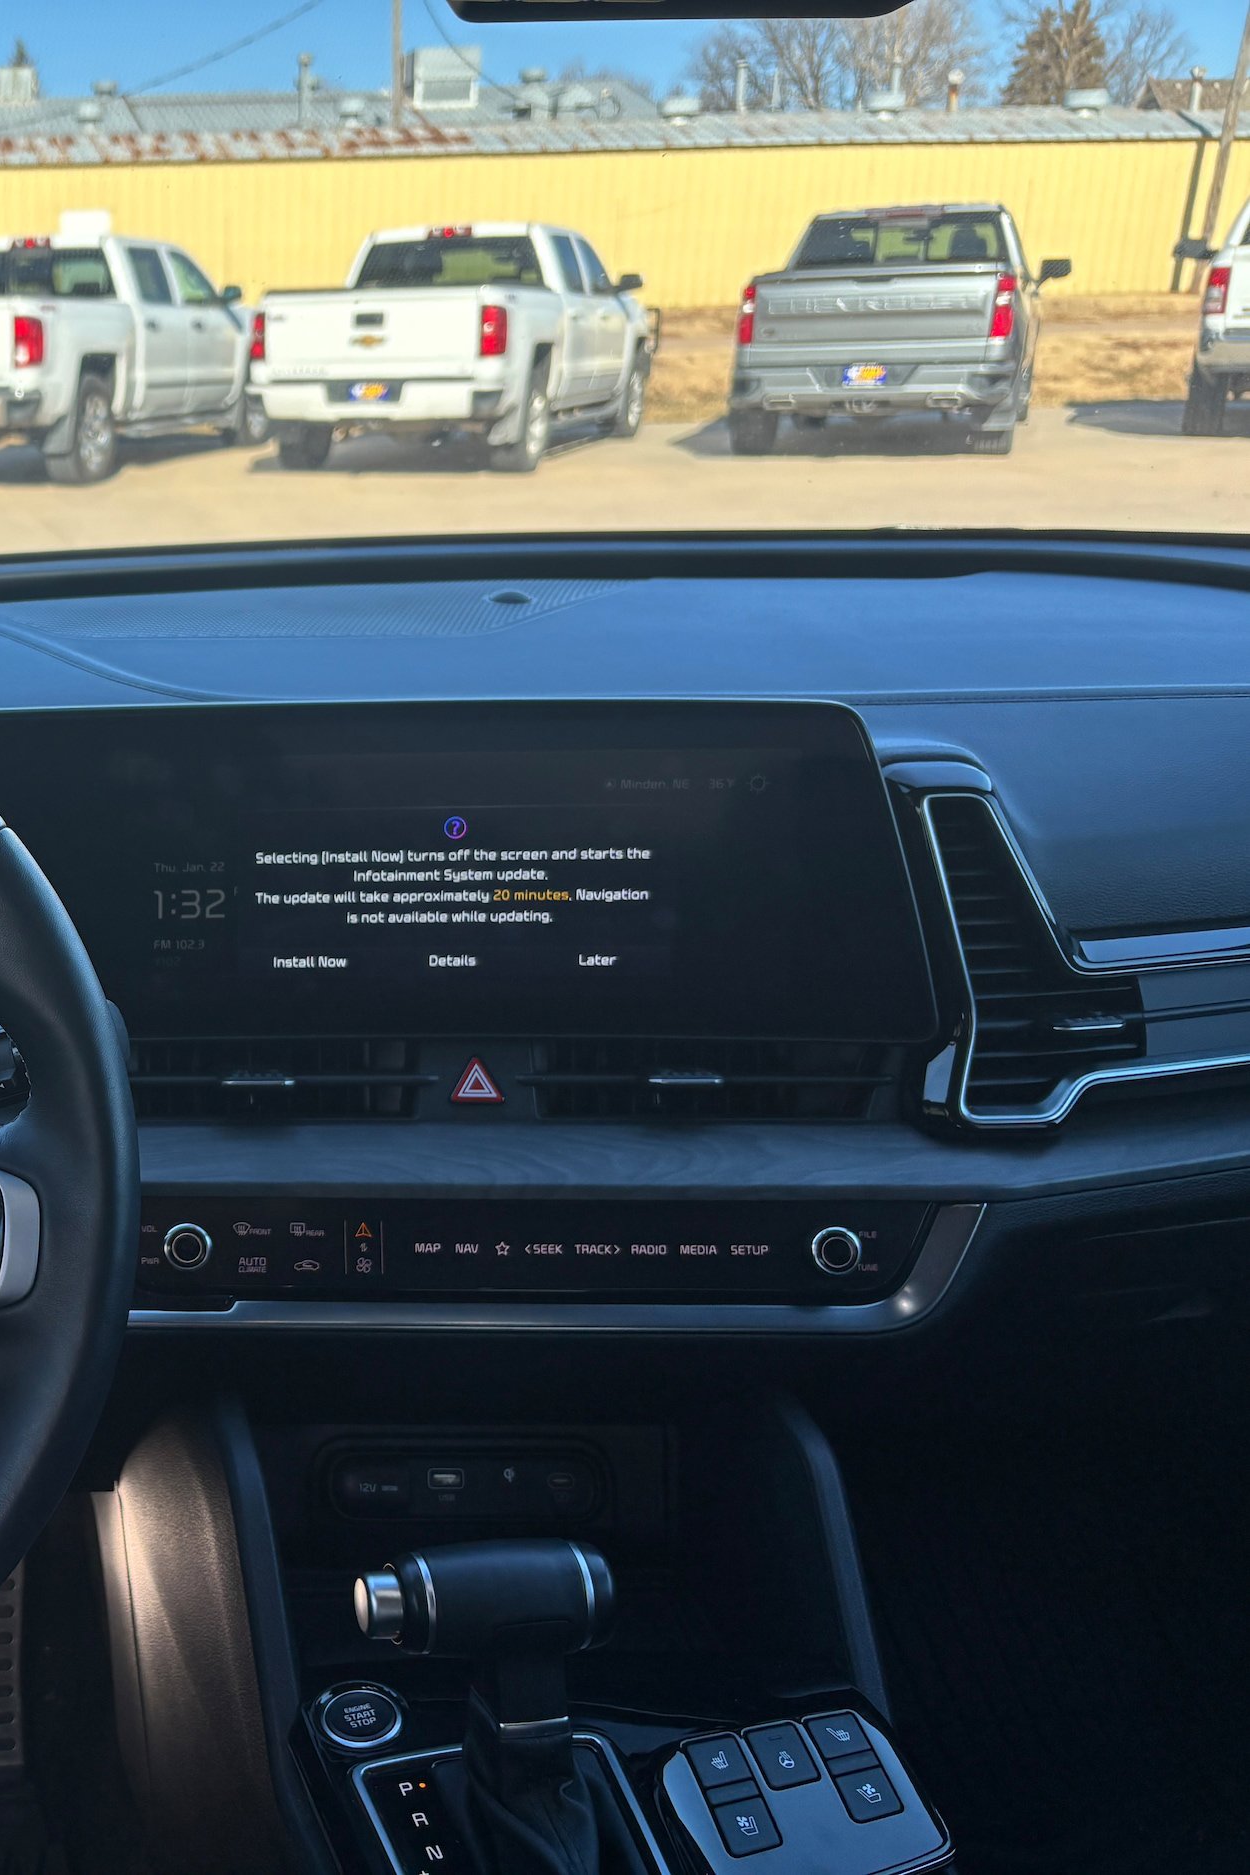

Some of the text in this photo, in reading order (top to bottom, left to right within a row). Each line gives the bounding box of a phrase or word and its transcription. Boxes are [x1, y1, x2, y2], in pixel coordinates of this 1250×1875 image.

[255, 847, 651, 866] Selecting [Install Now] turns off the screen and starts the
[209, 861, 225, 873] 22
[353, 867, 549, 883] Infotainment System update.
[255, 892, 281, 905] The
[283, 891, 331, 906] update
[333, 891, 357, 904] will
[359, 890, 390, 903] take
[392, 889, 490, 905] approximately
[493, 889, 511, 901] 20
[575, 888, 650, 903] Navigation
[153, 888, 226, 920] 1:32
[346, 909, 554, 924] is not available while updating.
[153, 939, 172, 950] FM
[273, 955, 347, 969] Install Now
[428, 954, 477, 968] Details
[578, 954, 617, 967] Later
[141, 1225, 158, 1233] VOL
[248, 1227, 273, 1236] FRONT
[305, 1228, 327, 1237] REAR
[858, 1230, 878, 1239] FILE
[414, 1243, 442, 1256] MAP
[455, 1243, 479, 1254] NAV
[630, 1244, 668, 1256] RADIO
[679, 1244, 718, 1256] MEDIA
[730, 1244, 769, 1256] SETUP
[141, 1256, 160, 1265] PWR
[238, 1256, 267, 1267] AUTO
[238, 1266, 267, 1274] CLIMATE
[857, 1263, 879, 1273] TUNE
[359, 1482, 376, 1494] 12V
[343, 1702, 371, 1714] ENGINE
[343, 1709, 376, 1722] START
[349, 1716, 377, 1729] STOP
[398, 1781, 414, 1797] P
[411, 1812, 429, 1828] R
[425, 1844, 444, 1861] N
